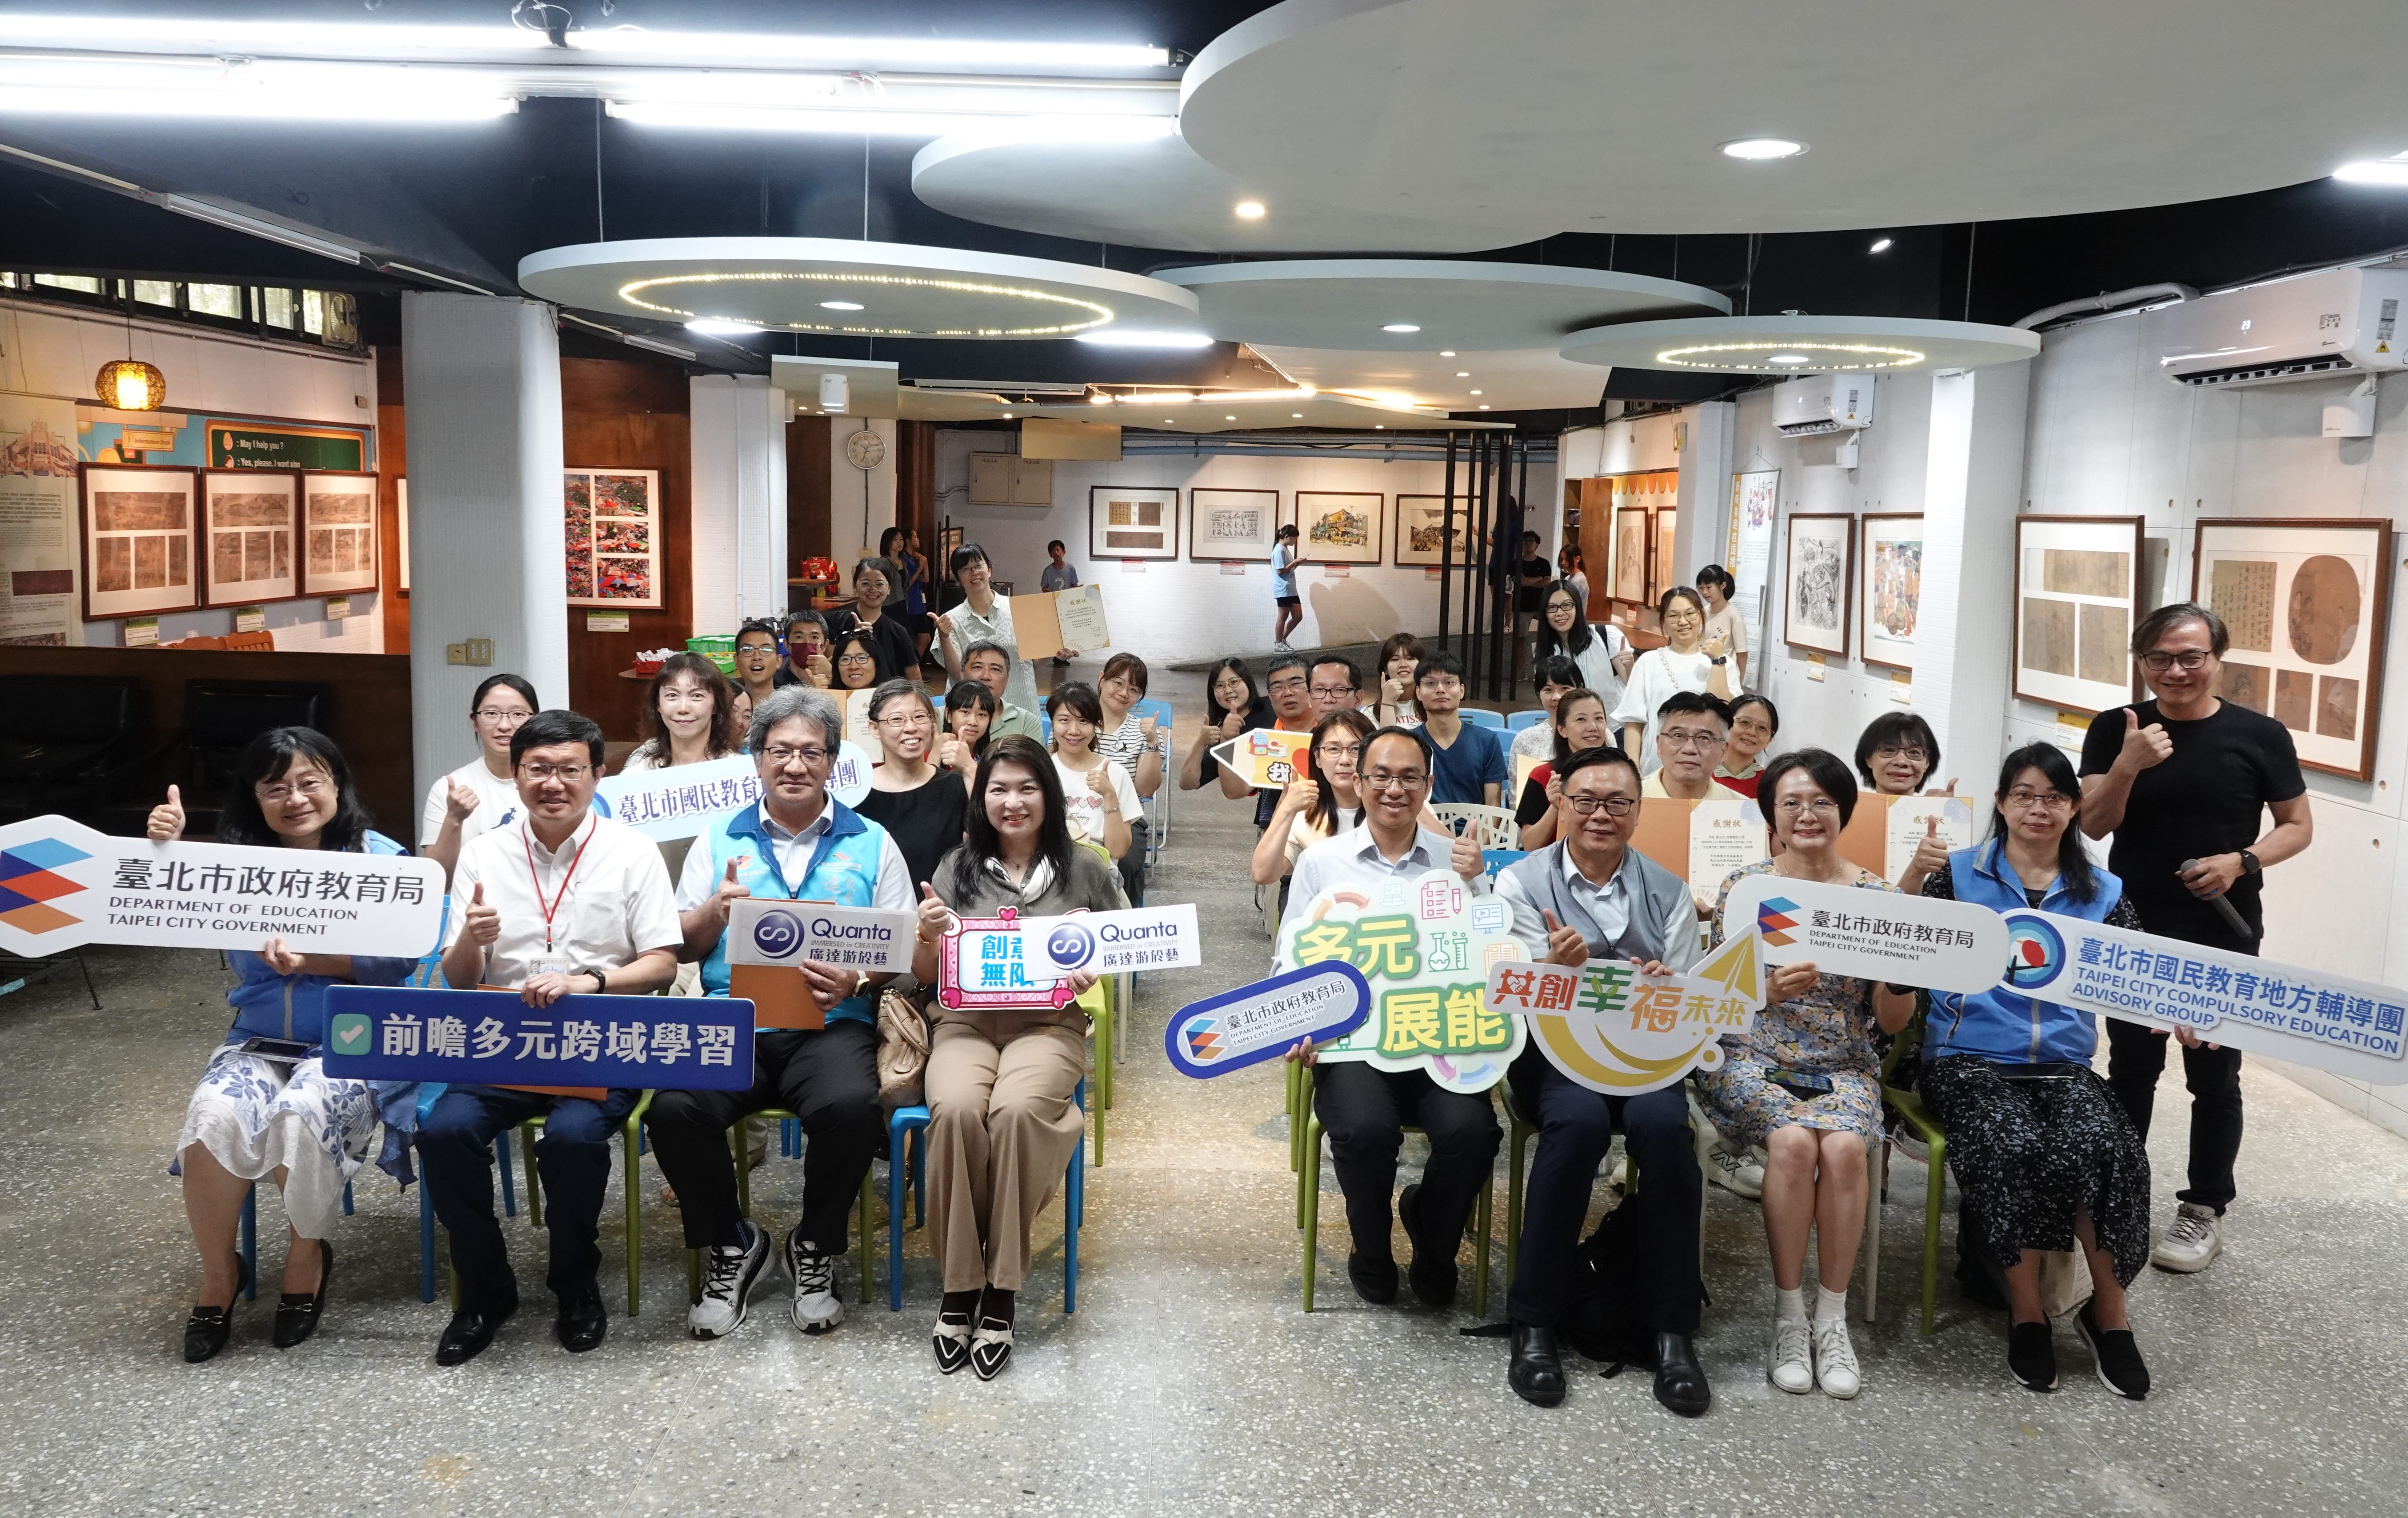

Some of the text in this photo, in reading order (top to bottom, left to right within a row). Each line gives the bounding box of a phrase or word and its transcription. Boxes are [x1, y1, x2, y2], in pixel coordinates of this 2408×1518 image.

[240, 439, 251, 450] May
[256, 441, 268, 450] help
[1395, 715, 1421, 724] ATISS
[1268, 761, 1291, 783] 我
[1069, 809, 1090, 824] Happy
[1713, 819, 1742, 828] 感謝狀
[113, 858, 424, 905] 臺北市政府教育局
[110, 897, 358, 920] DEPARTMENT OF EDUCATION
[107, 914, 328, 935] TAIPEI CITY GOVERNMENT
[811, 918, 891, 941] Quanta
[1100, 922, 1177, 942] Quanta
[1811, 910, 1974, 948] 臺北市政府教育局
[1299, 919, 1413, 977] 多元
[1809, 939, 1835, 948] TAIPEI
[1860, 948, 1921, 961] GOVERNMENT
[1810, 930, 1866, 944] DEPARTMENT
[1885, 941, 1937, 954] EDUCATION
[810, 948, 888, 965] 廣達游於藝
[1104, 948, 1179, 967] 廣達游於藝
[2078, 937, 2405, 1036] 臺北市國民教育地方輔導團
[1226, 980, 1346, 1031] 臺北市政府教育局
[1493, 966, 1749, 1033] 共創幸福未來
[2072, 983, 2214, 1025] ADVISORY GROUP
[2077, 967, 2398, 1054] TAIPEI CITY COMPULSORY EDUCATION
[1230, 1021, 1272, 1039] DEPARTMENT
[1285, 1004, 1324, 1021] EDUCATION
[1233, 1015, 1315, 1046] TAIPEI CITY GOVERNMENT
[1383, 987, 1506, 1053] 展能
[381, 1012, 736, 1066] 前瞻多元跨域學習
